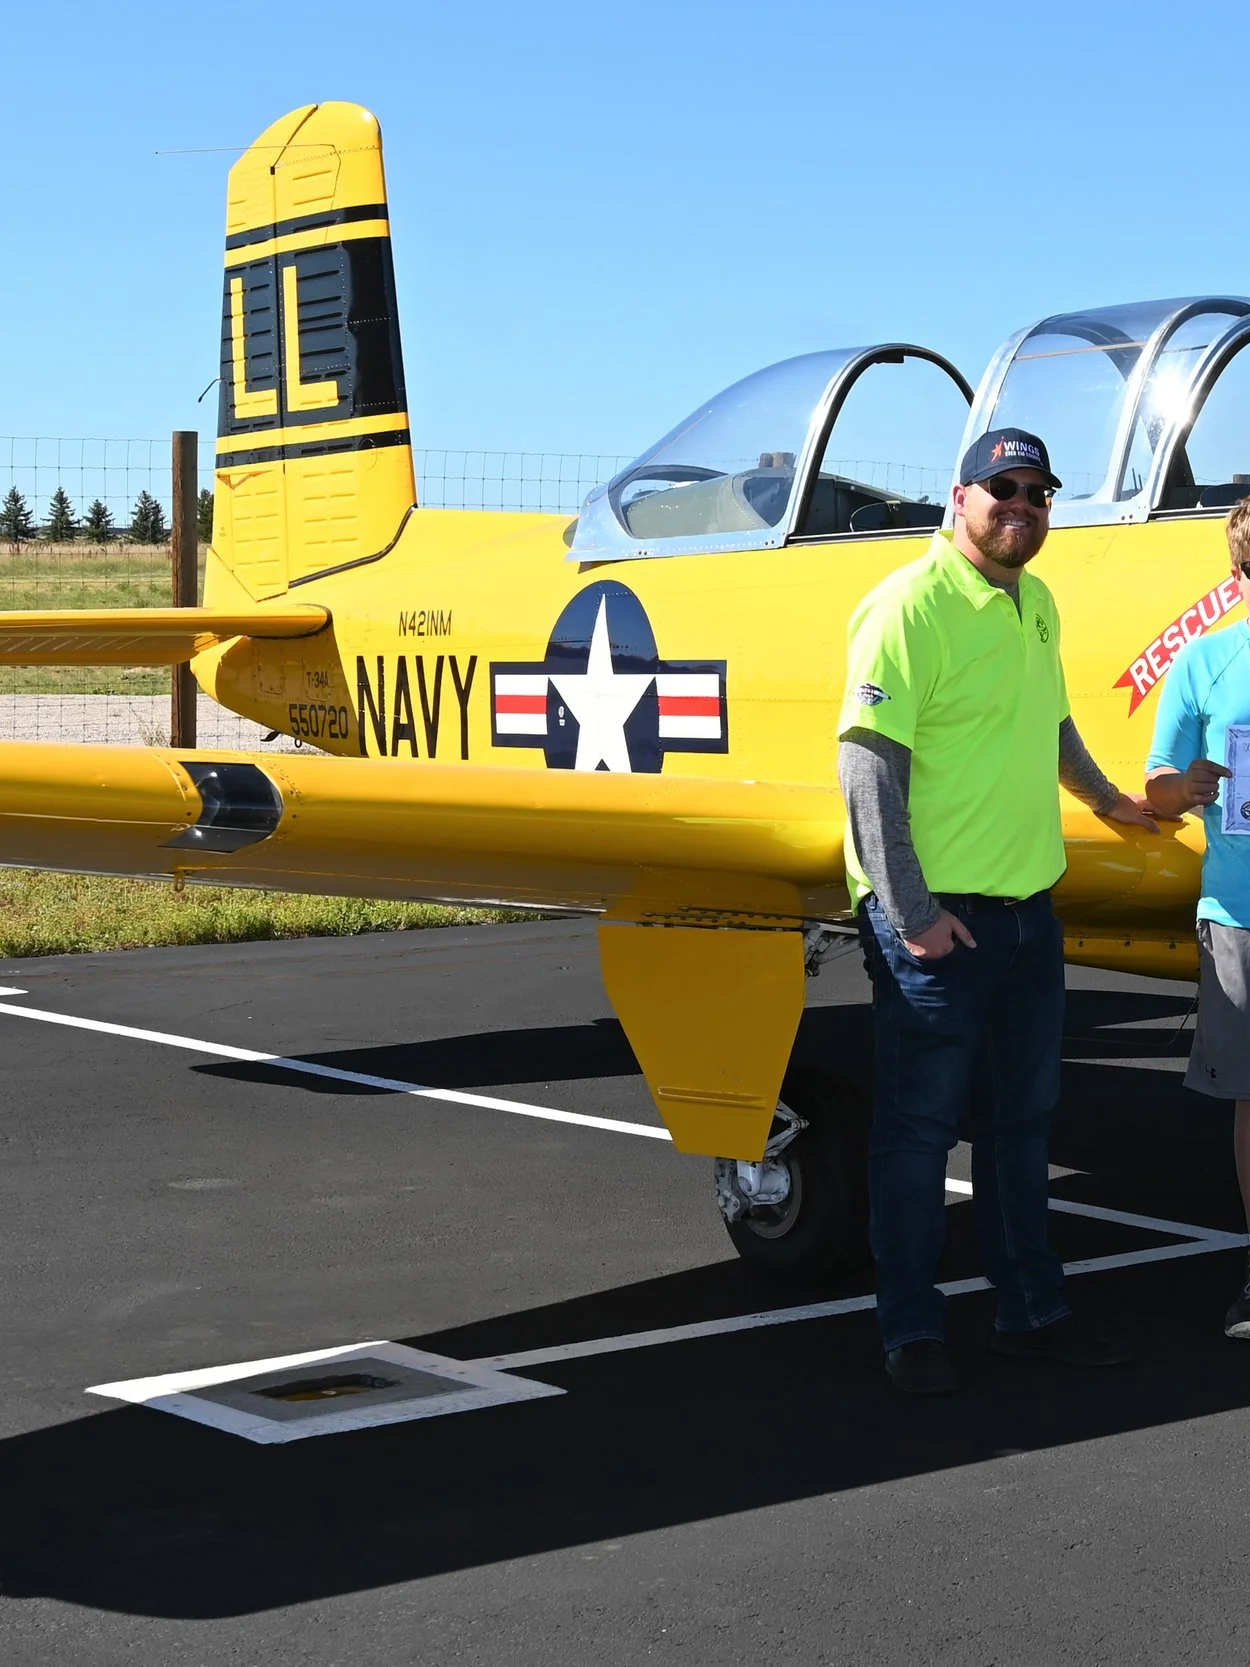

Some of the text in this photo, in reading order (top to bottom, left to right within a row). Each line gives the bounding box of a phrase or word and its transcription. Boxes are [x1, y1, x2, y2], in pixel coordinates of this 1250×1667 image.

[1004, 441, 1040, 457] WINGS
[1128, 576, 1243, 697] RESCUE
[306, 671, 330, 689] T-34A
[289, 703, 349, 740] 550720
[356, 655, 478, 761] NAVY
